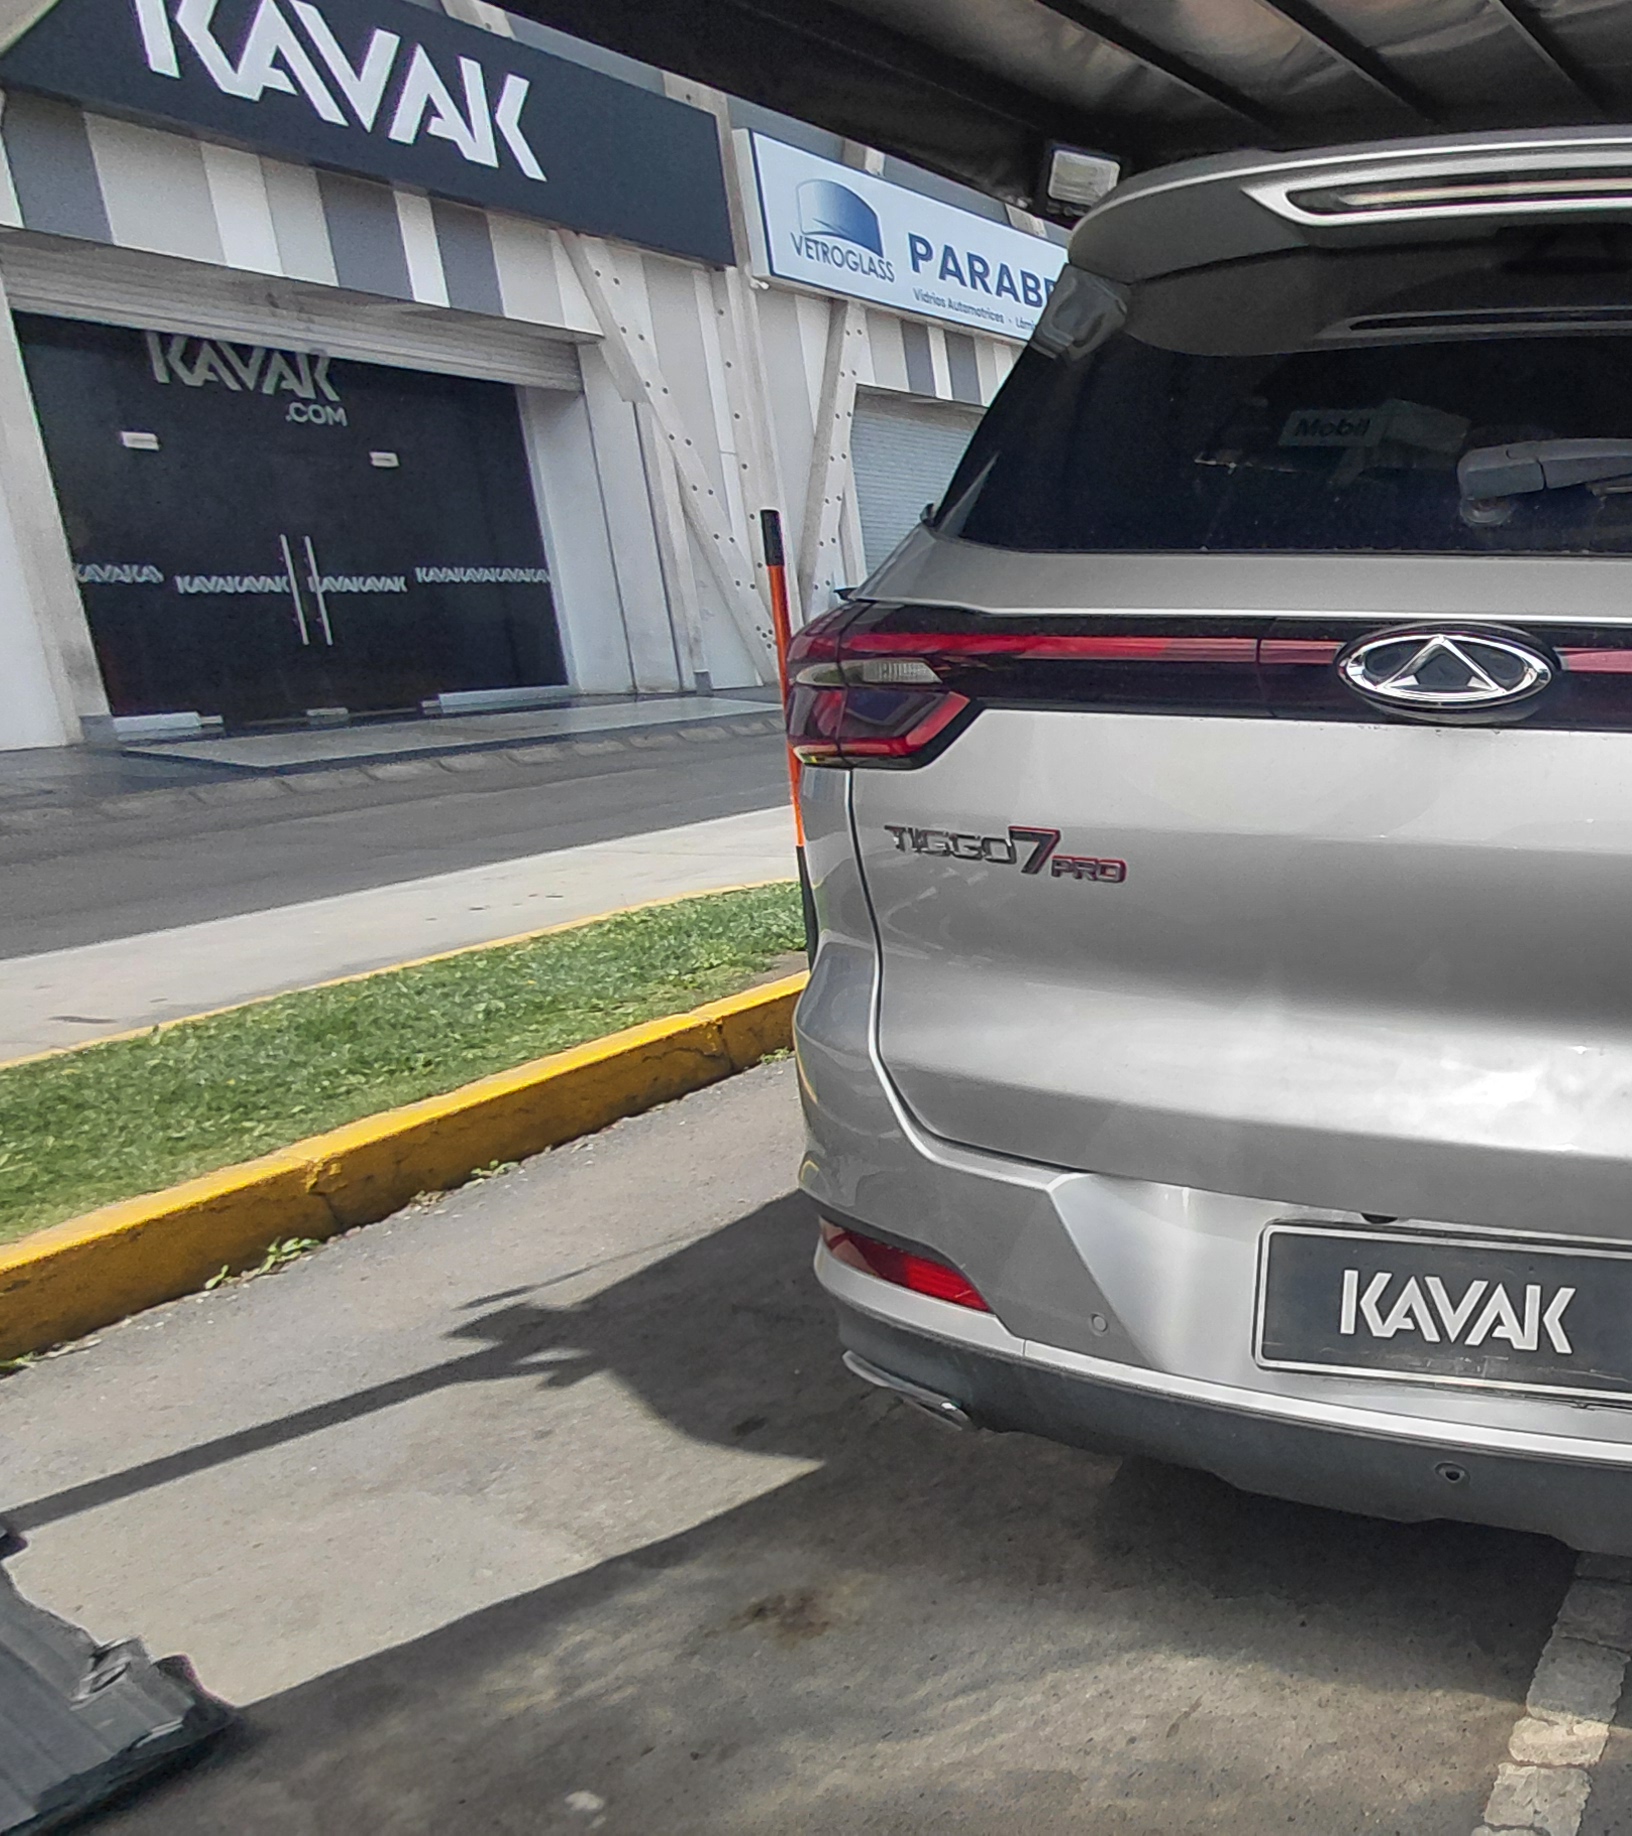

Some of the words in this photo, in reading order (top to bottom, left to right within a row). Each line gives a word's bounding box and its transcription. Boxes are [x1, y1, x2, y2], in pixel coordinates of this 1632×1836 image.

[135, 0, 547, 182] KAVAK
[790, 232, 895, 283] VETROGLASS
[912, 287, 946, 309] Vidrios
[947, 297, 1005, 324] Automotrices
[147, 332, 341, 402] KAVAK
[285, 402, 348, 427] .COM
[1294, 417, 1371, 437] Mobil
[1051, 855, 1127, 884] PRO
[1339, 1268, 1577, 1355] KAVAK
